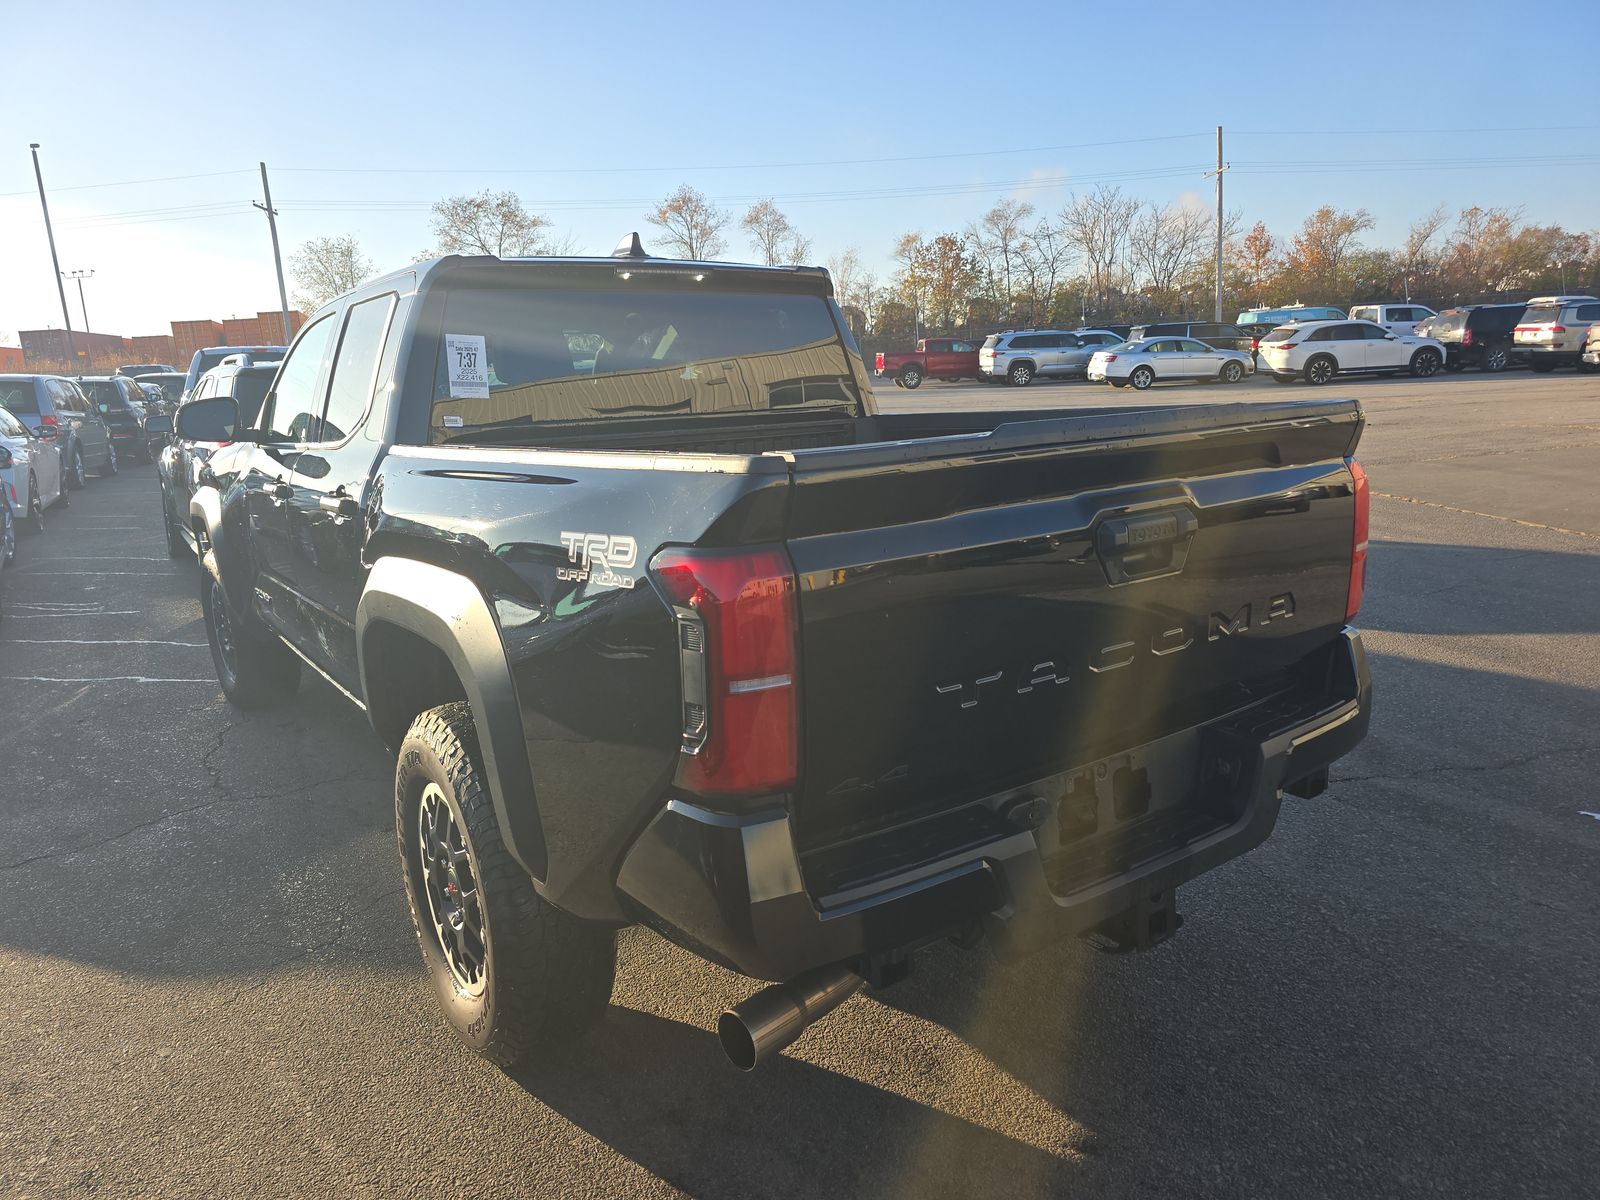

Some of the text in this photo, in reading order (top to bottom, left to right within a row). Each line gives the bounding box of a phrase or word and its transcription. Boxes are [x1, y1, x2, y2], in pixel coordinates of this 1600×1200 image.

[457, 352, 477, 368] 7:37
[1132, 525, 1176, 542] TOYOTA
[560, 531, 637, 577] TRD
[556, 567, 635, 589] OFF ROAD
[936, 591, 1296, 709] TACOMA
